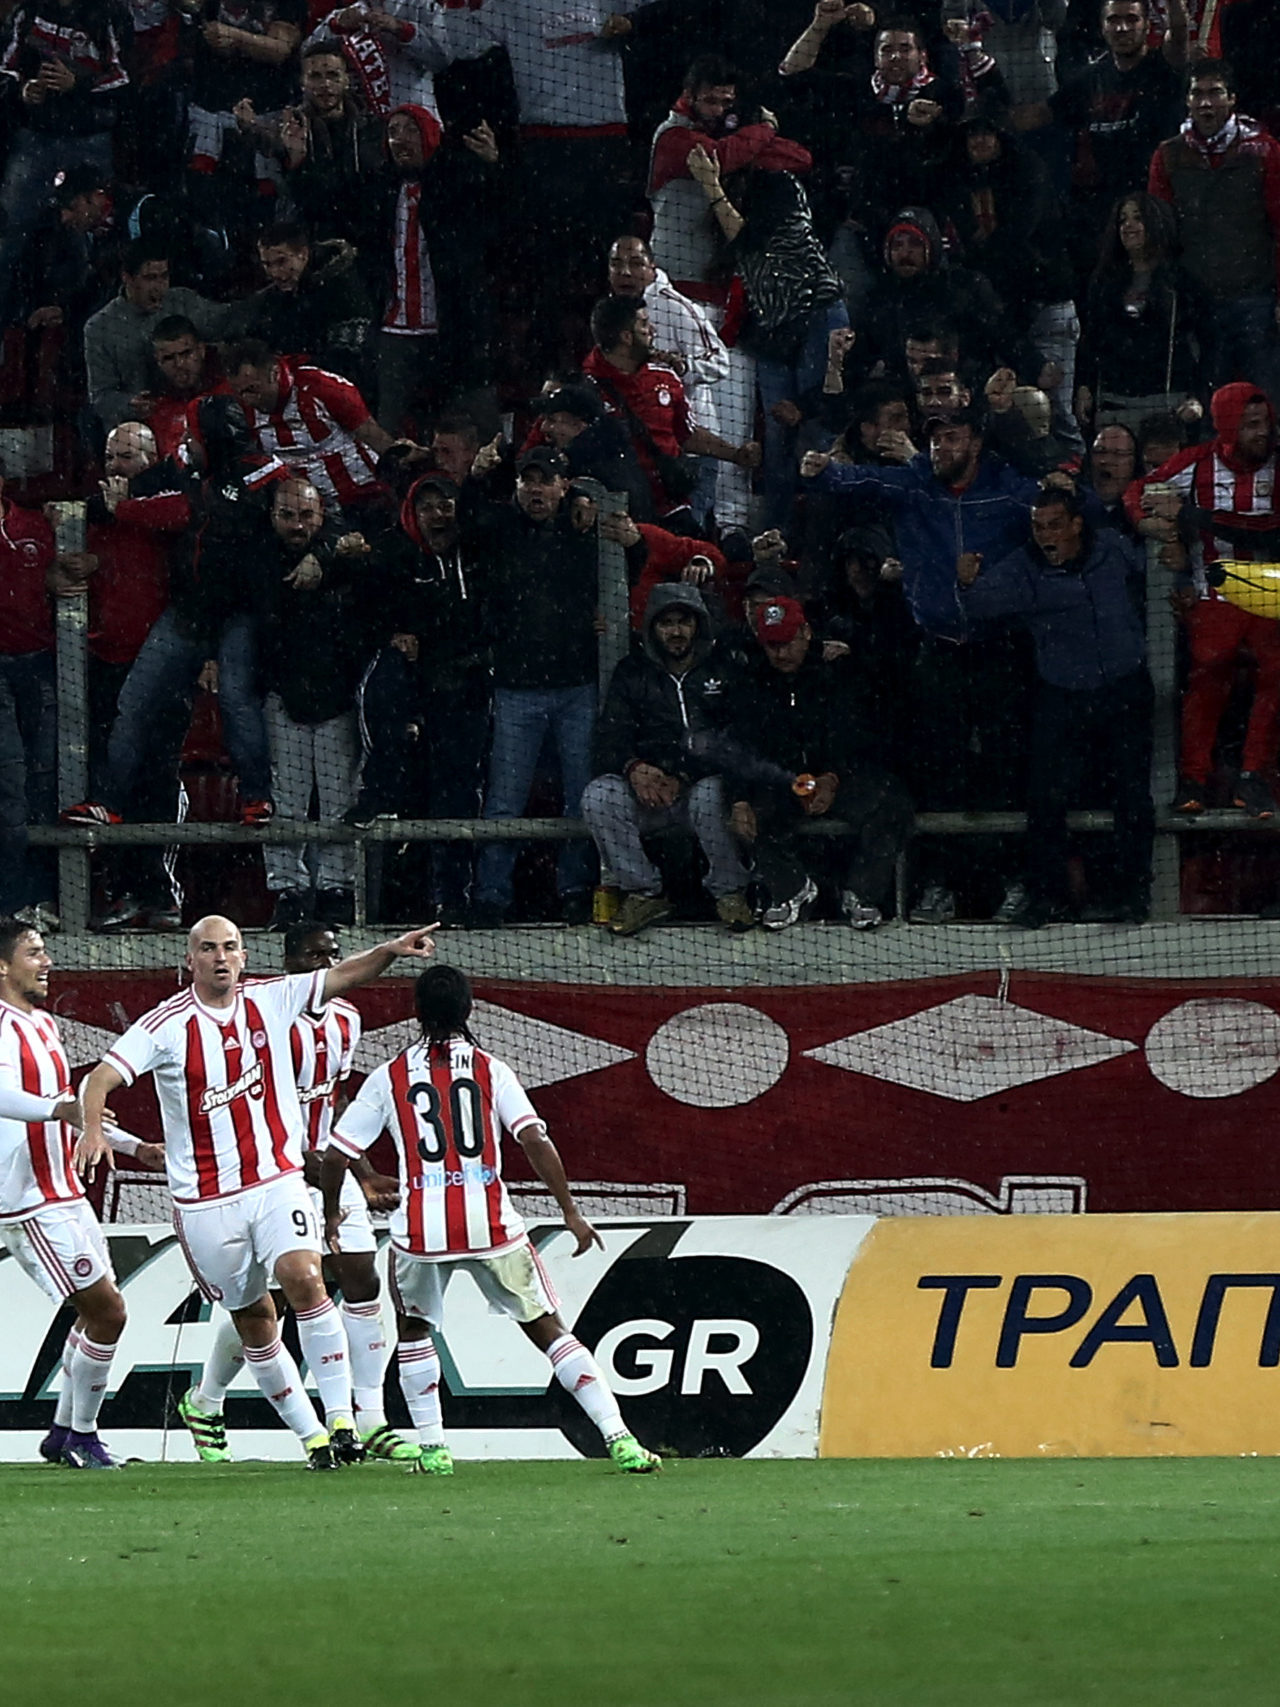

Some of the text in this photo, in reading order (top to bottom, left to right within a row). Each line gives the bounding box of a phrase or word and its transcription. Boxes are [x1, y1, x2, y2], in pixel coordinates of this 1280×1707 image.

[407, 1078, 484, 1162] 30
[292, 1209, 319, 1240] 9
[593, 1317, 761, 1397] GR
